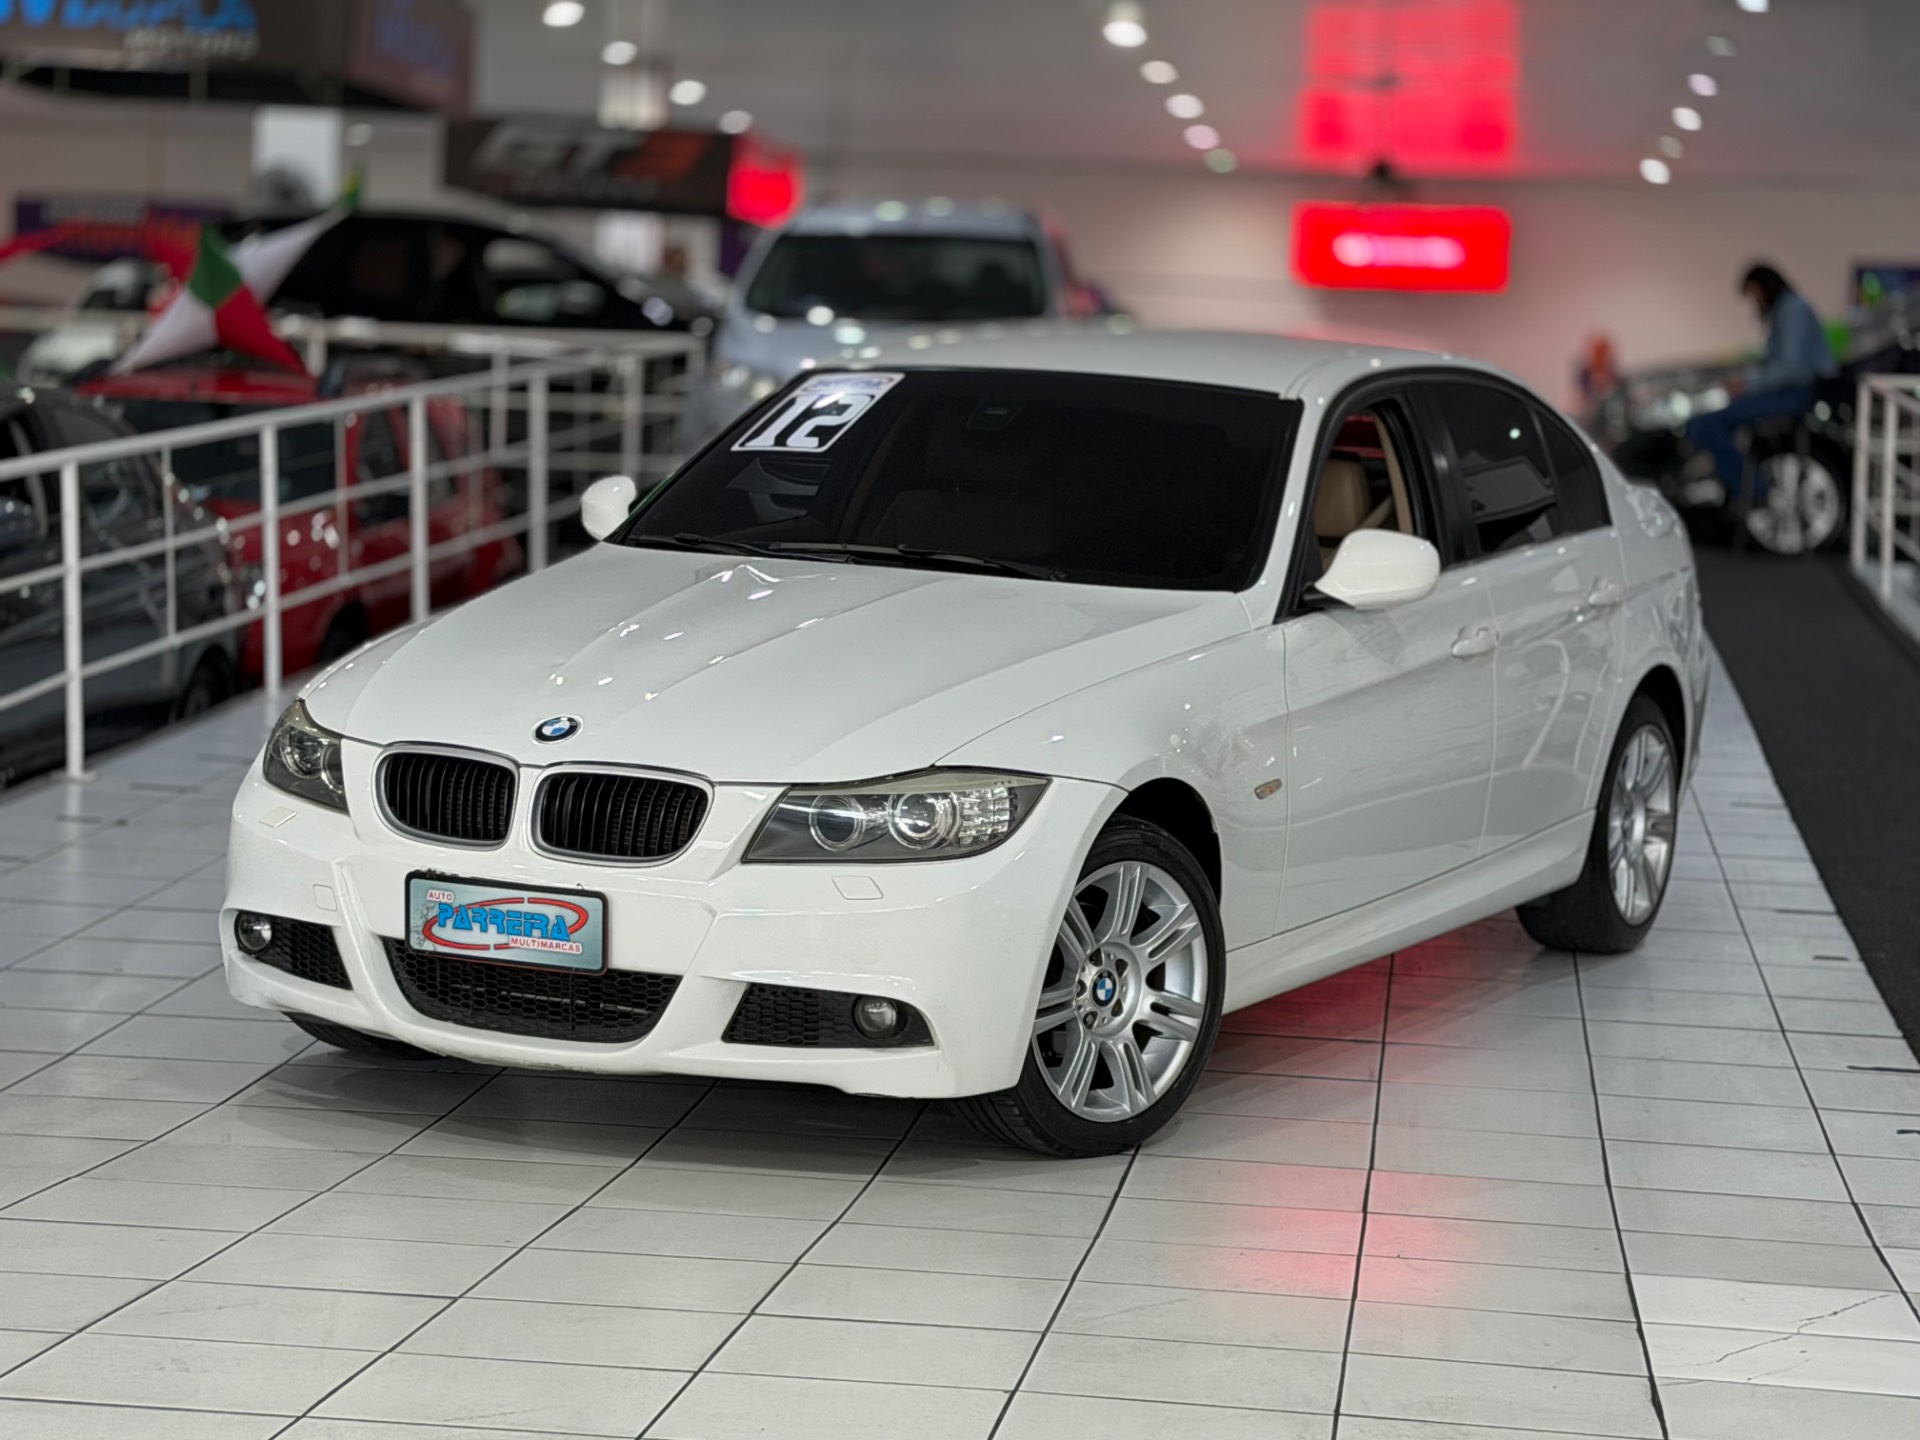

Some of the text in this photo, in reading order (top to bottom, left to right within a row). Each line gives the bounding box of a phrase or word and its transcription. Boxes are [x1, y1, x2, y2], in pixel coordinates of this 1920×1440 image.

[743, 394, 873, 448] 12
[427, 890, 453, 902] AUTO
[437, 902, 571, 941] PARREIRA
[510, 937, 582, 953] MULTIMARCAS
